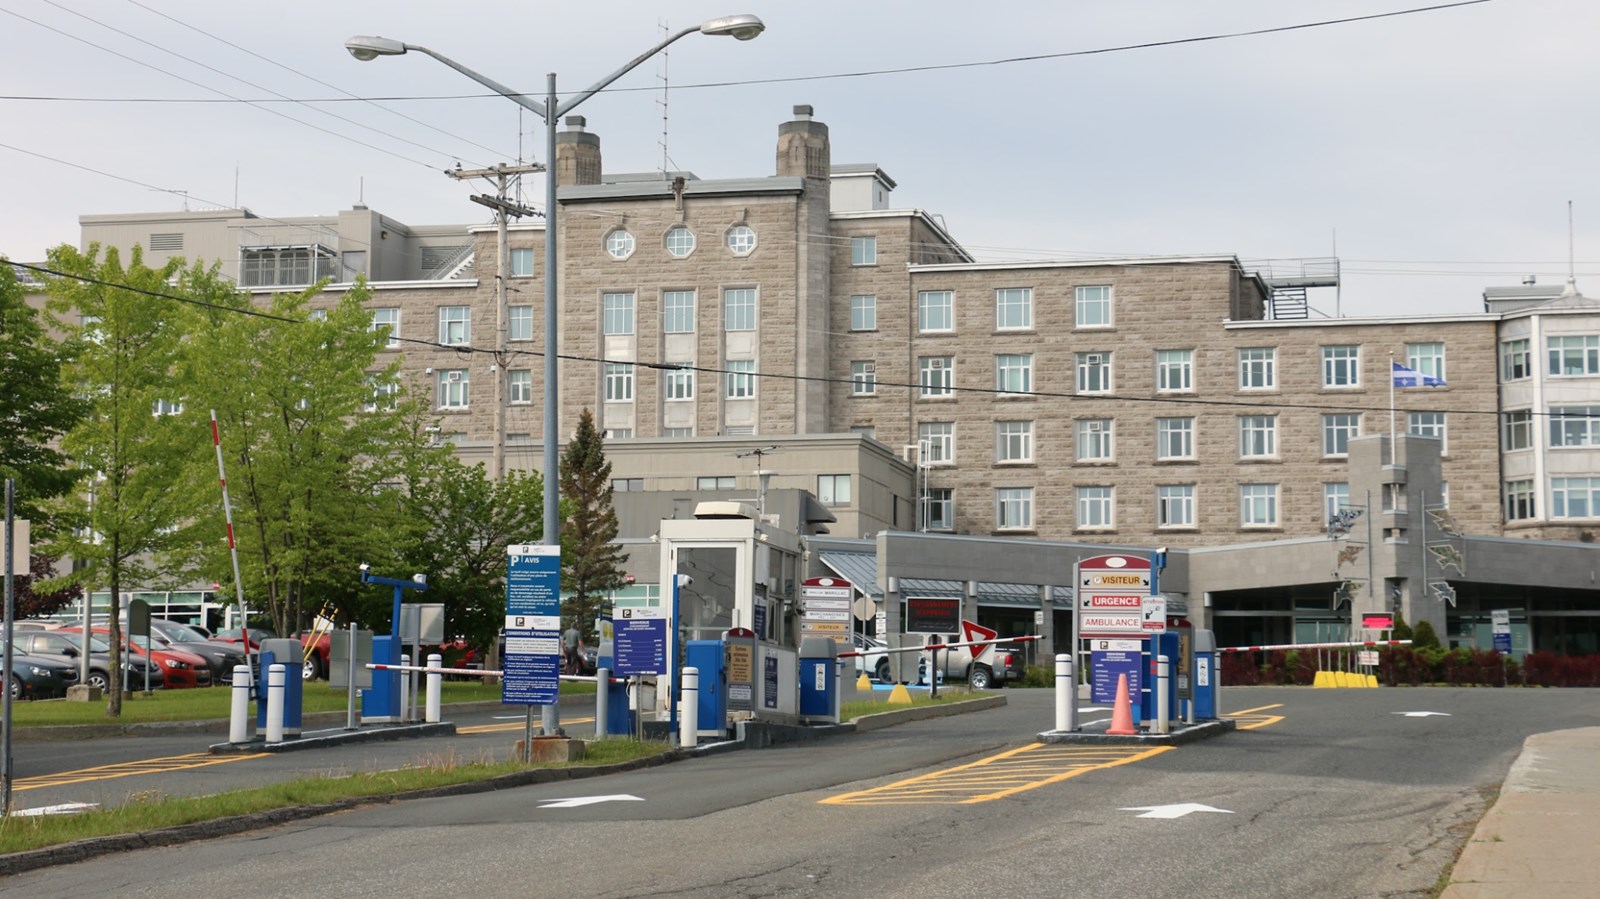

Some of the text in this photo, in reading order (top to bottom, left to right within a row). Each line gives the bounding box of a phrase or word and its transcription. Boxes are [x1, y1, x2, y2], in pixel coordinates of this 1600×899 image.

[511, 555, 519, 566] P
[1102, 576, 1140, 584] VISITEUR
[1094, 598, 1138, 606] URGENCE
